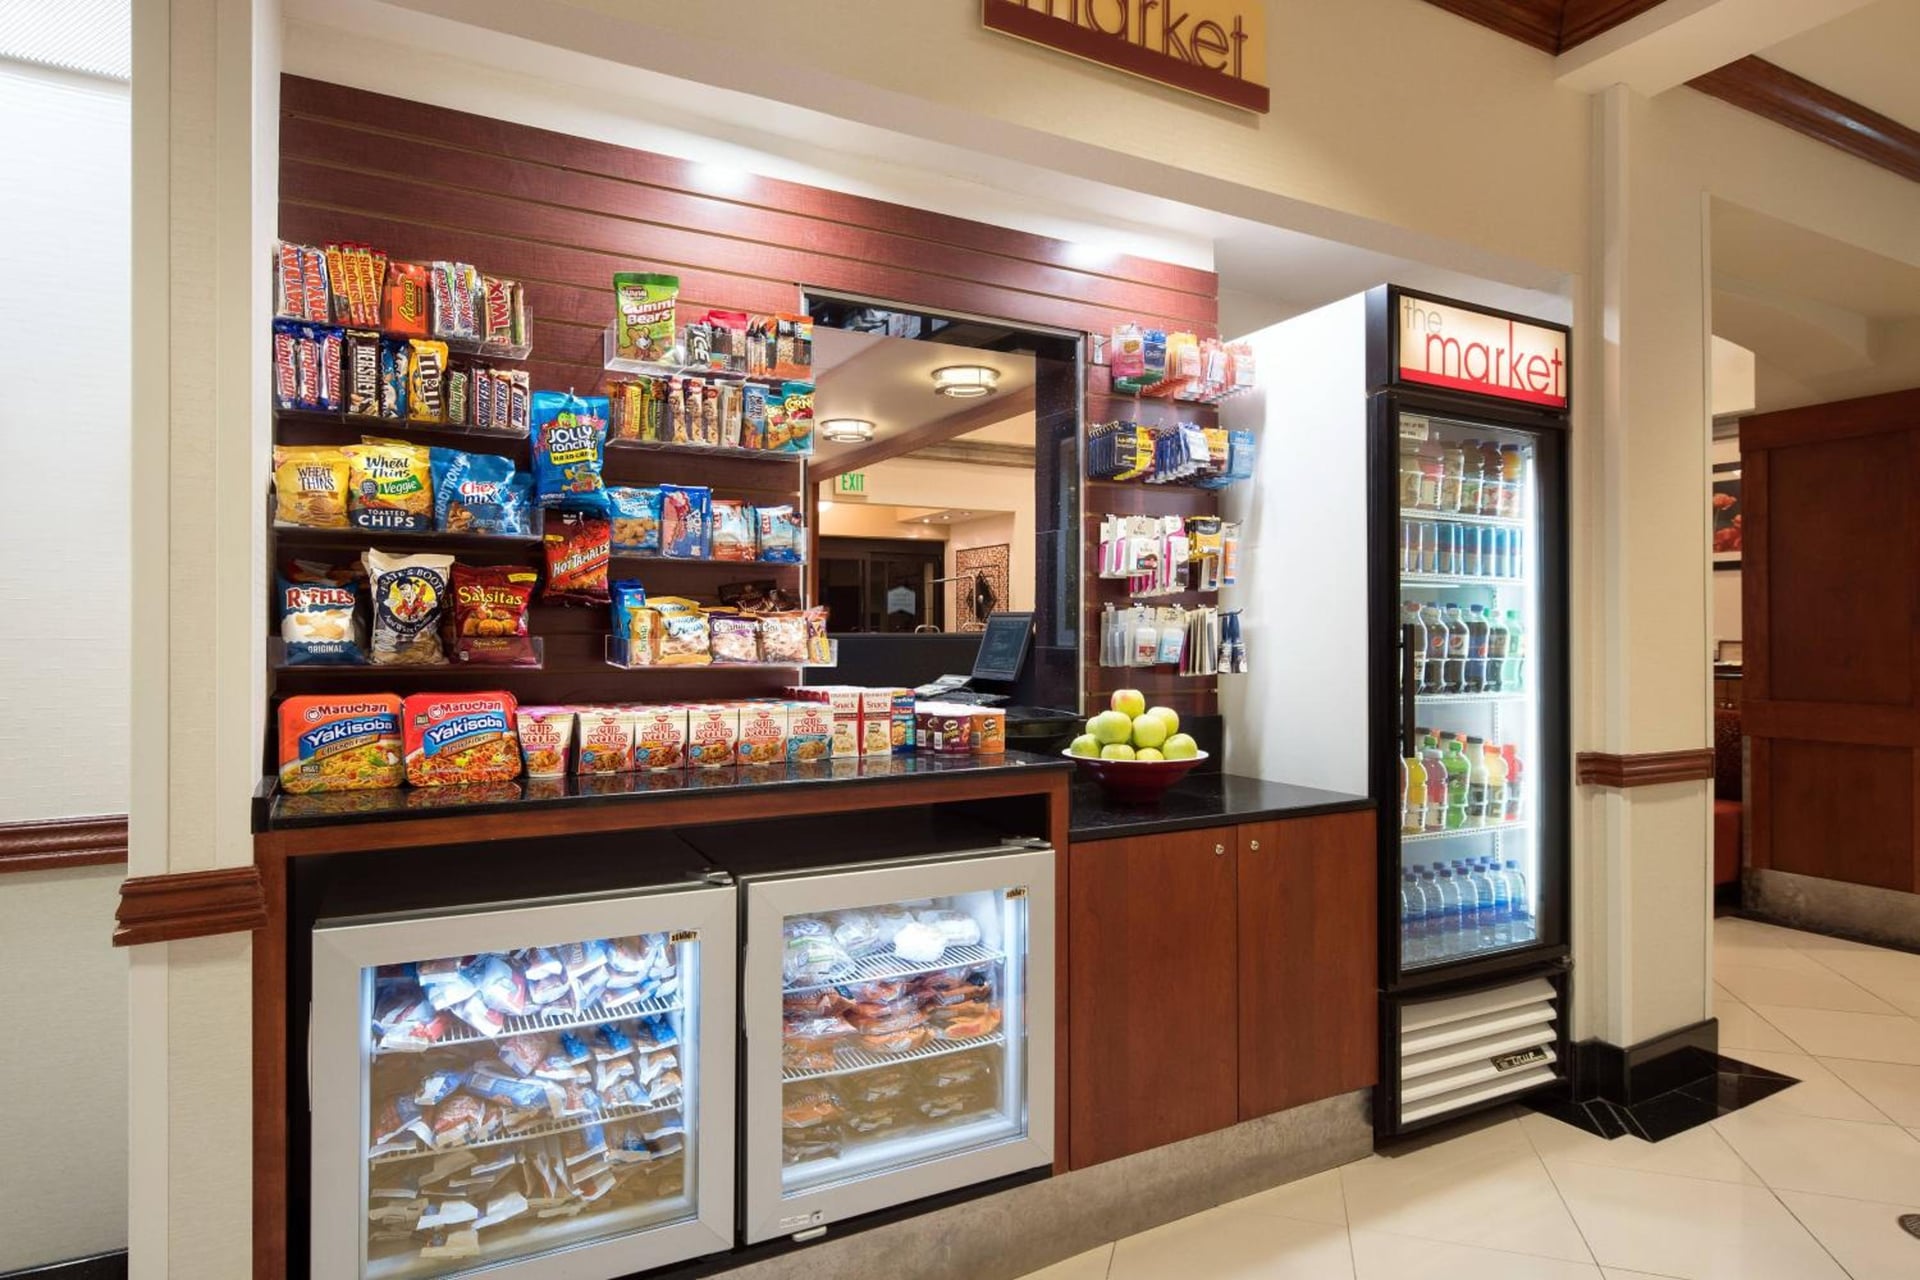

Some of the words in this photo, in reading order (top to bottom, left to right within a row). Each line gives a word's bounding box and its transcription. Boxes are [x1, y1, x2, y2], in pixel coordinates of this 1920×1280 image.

[281, 244, 304, 315] PAYDAY
[303, 251, 328, 321] PAYDAY
[344, 254, 361, 303] Starburst
[360, 255, 377, 305] Starburst
[489, 282, 510, 335] TWIX
[622, 296, 676, 314] Gummi
[627, 309, 671, 326] Bears
[1404, 298, 1442, 333] the
[1426, 319, 1563, 397] market
[356, 345, 377, 404] HERSHEY'S
[477, 378, 491, 427] SNICKERS
[495, 380, 508, 423] SNICKERS
[548, 425, 593, 443] JOLLY
[552, 439, 596, 452] rancher
[366, 455, 410, 469] Wheat
[297, 466, 333, 479] WHEAT
[364, 466, 411, 479] Thins
[302, 475, 335, 491] THINS
[383, 480, 418, 494] Veggie
[461, 482, 496, 495] Chex
[842, 471, 864, 492] EXIT
[358, 514, 415, 528] CHIPS
[368, 508, 406, 517] TOASTED
[552, 559, 572, 578] HOT
[571, 541, 610, 568] TAMALES
[416, 567, 444, 596] BOOTY
[286, 587, 355, 609] RFFLES
[457, 584, 523, 605] Salsitas
[307, 645, 344, 654] ORIGINAL
[318, 703, 388, 715] Maruchan
[440, 701, 502, 714] Maruchan
[307, 719, 393, 749] Yakisoba
[430, 716, 504, 744] Yakisoba
[521, 732, 561, 745] NOODLES
[641, 731, 681, 742] NOODLES
[696, 728, 733, 740] NOODLES
[744, 727, 782, 738] NOODLES
[793, 725, 828, 736] NOODLES
[587, 734, 628, 745] NOODLES
